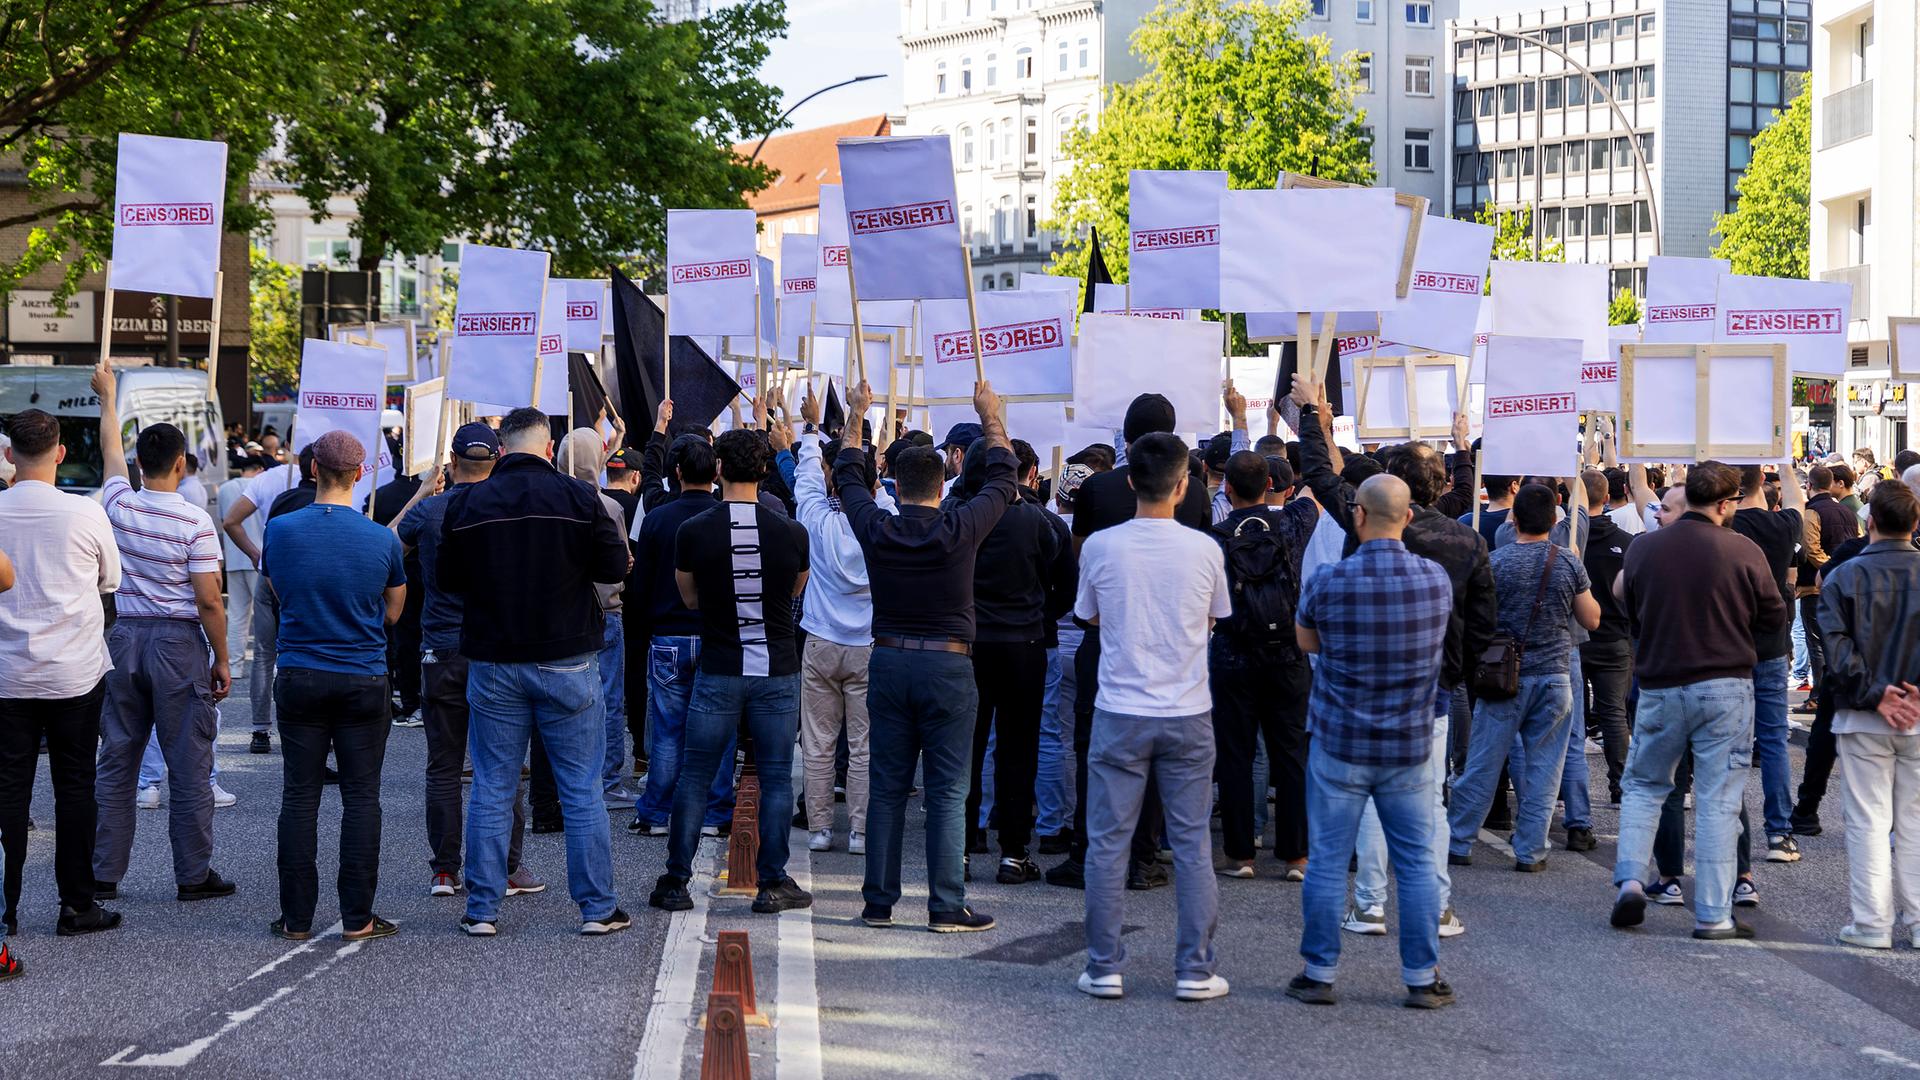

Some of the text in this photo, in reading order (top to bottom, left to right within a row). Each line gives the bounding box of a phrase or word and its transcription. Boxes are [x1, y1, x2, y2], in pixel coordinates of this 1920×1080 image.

[125, 207, 209, 221] CENSORED
[855, 206, 945, 230] ZENSIERT
[1137, 229, 1216, 247] ZENSIERT
[676, 263, 748, 280] CENSORED
[1651, 308, 1716, 320] ZENSIERT
[1731, 313, 1835, 330] ZENSIERT
[43, 322, 59, 333] 32
[112, 317, 149, 332] IZIM
[461, 316, 532, 332] ZENSIERT
[306, 395, 373, 408] VERBOTEN
[1493, 396, 1571, 414] ZENSIERT
[730, 520, 768, 646] JORDAN
